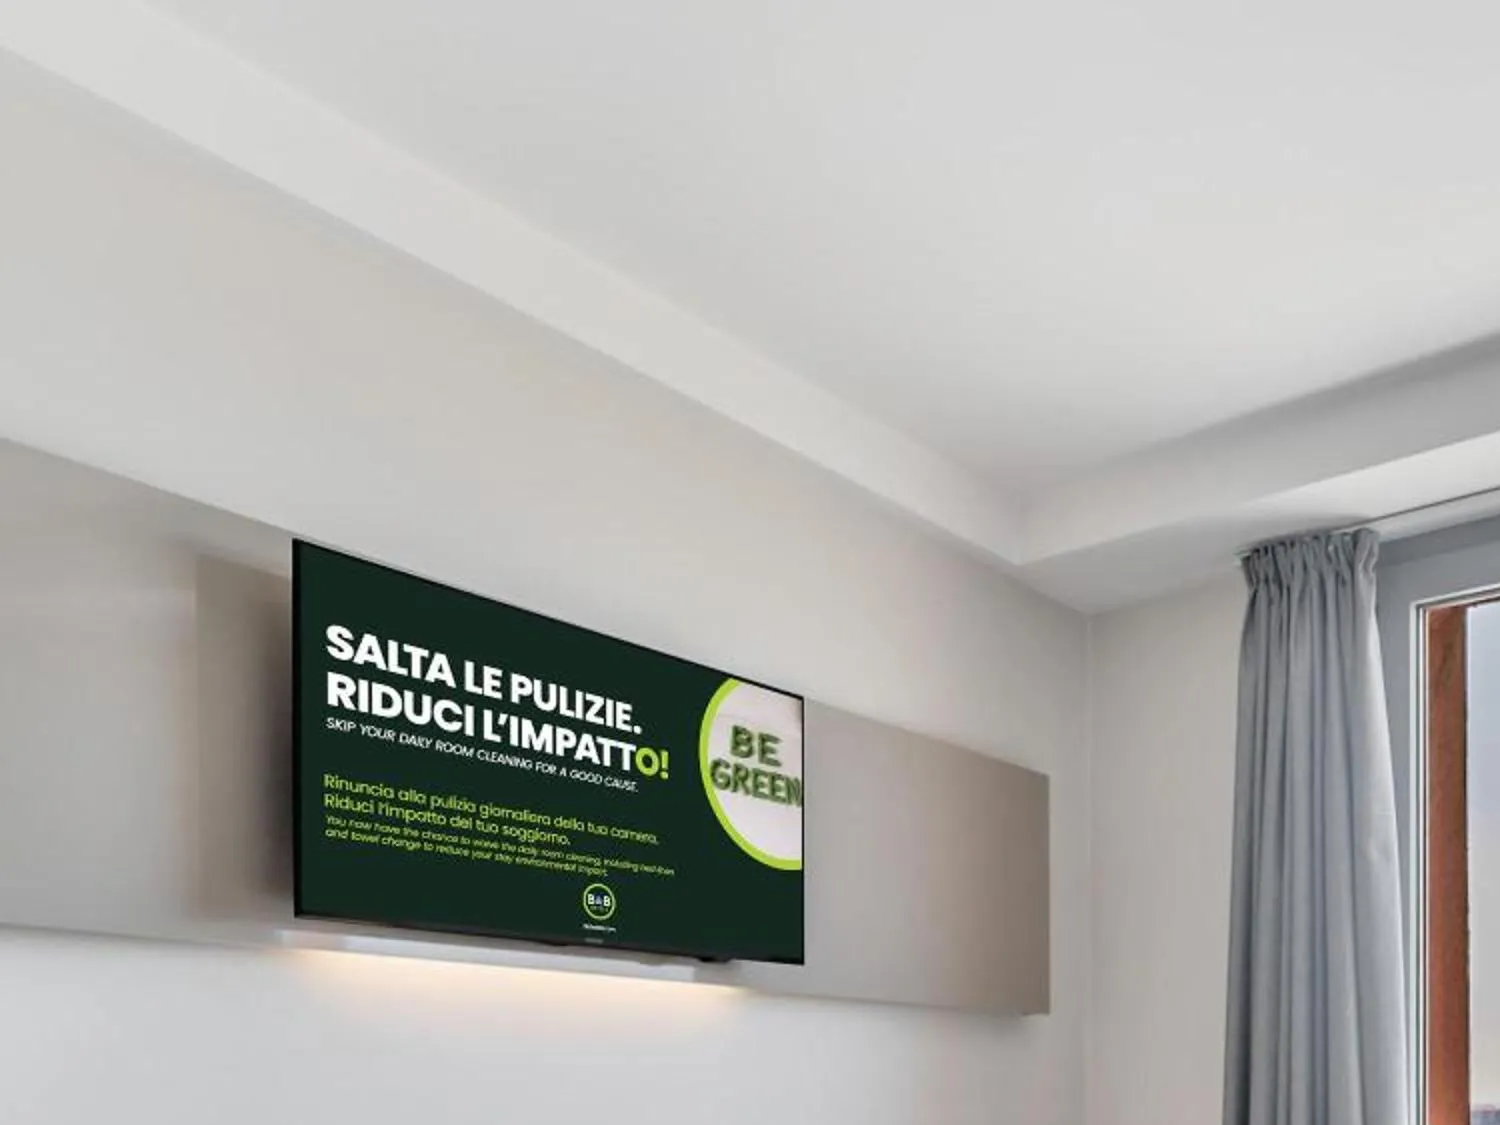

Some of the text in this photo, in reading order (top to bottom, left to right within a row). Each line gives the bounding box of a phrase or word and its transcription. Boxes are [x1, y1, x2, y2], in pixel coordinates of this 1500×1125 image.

[326, 624, 642, 734] SALTA LE PULIZIE.
[327, 671, 475, 737] RIDUCI
[326, 717, 639, 793] SKIP YOUR DAILY ROOM CLEANING FOR A GOOD CAUSE.
[731, 725, 783, 767] BE
[323, 773, 395, 799] Rinuncia
[398, 788, 427, 805] alla
[430, 794, 477, 813] pulizia
[479, 802, 551, 826] giornaliera
[553, 816, 585, 832] della
[587, 822, 608, 835] tua
[710, 758, 802, 807] GREEN
[323, 793, 375, 815] Riduci
[449, 815, 473, 830] del
[475, 819, 499, 833] tuo
[501, 825, 571, 846] soggiorno.
